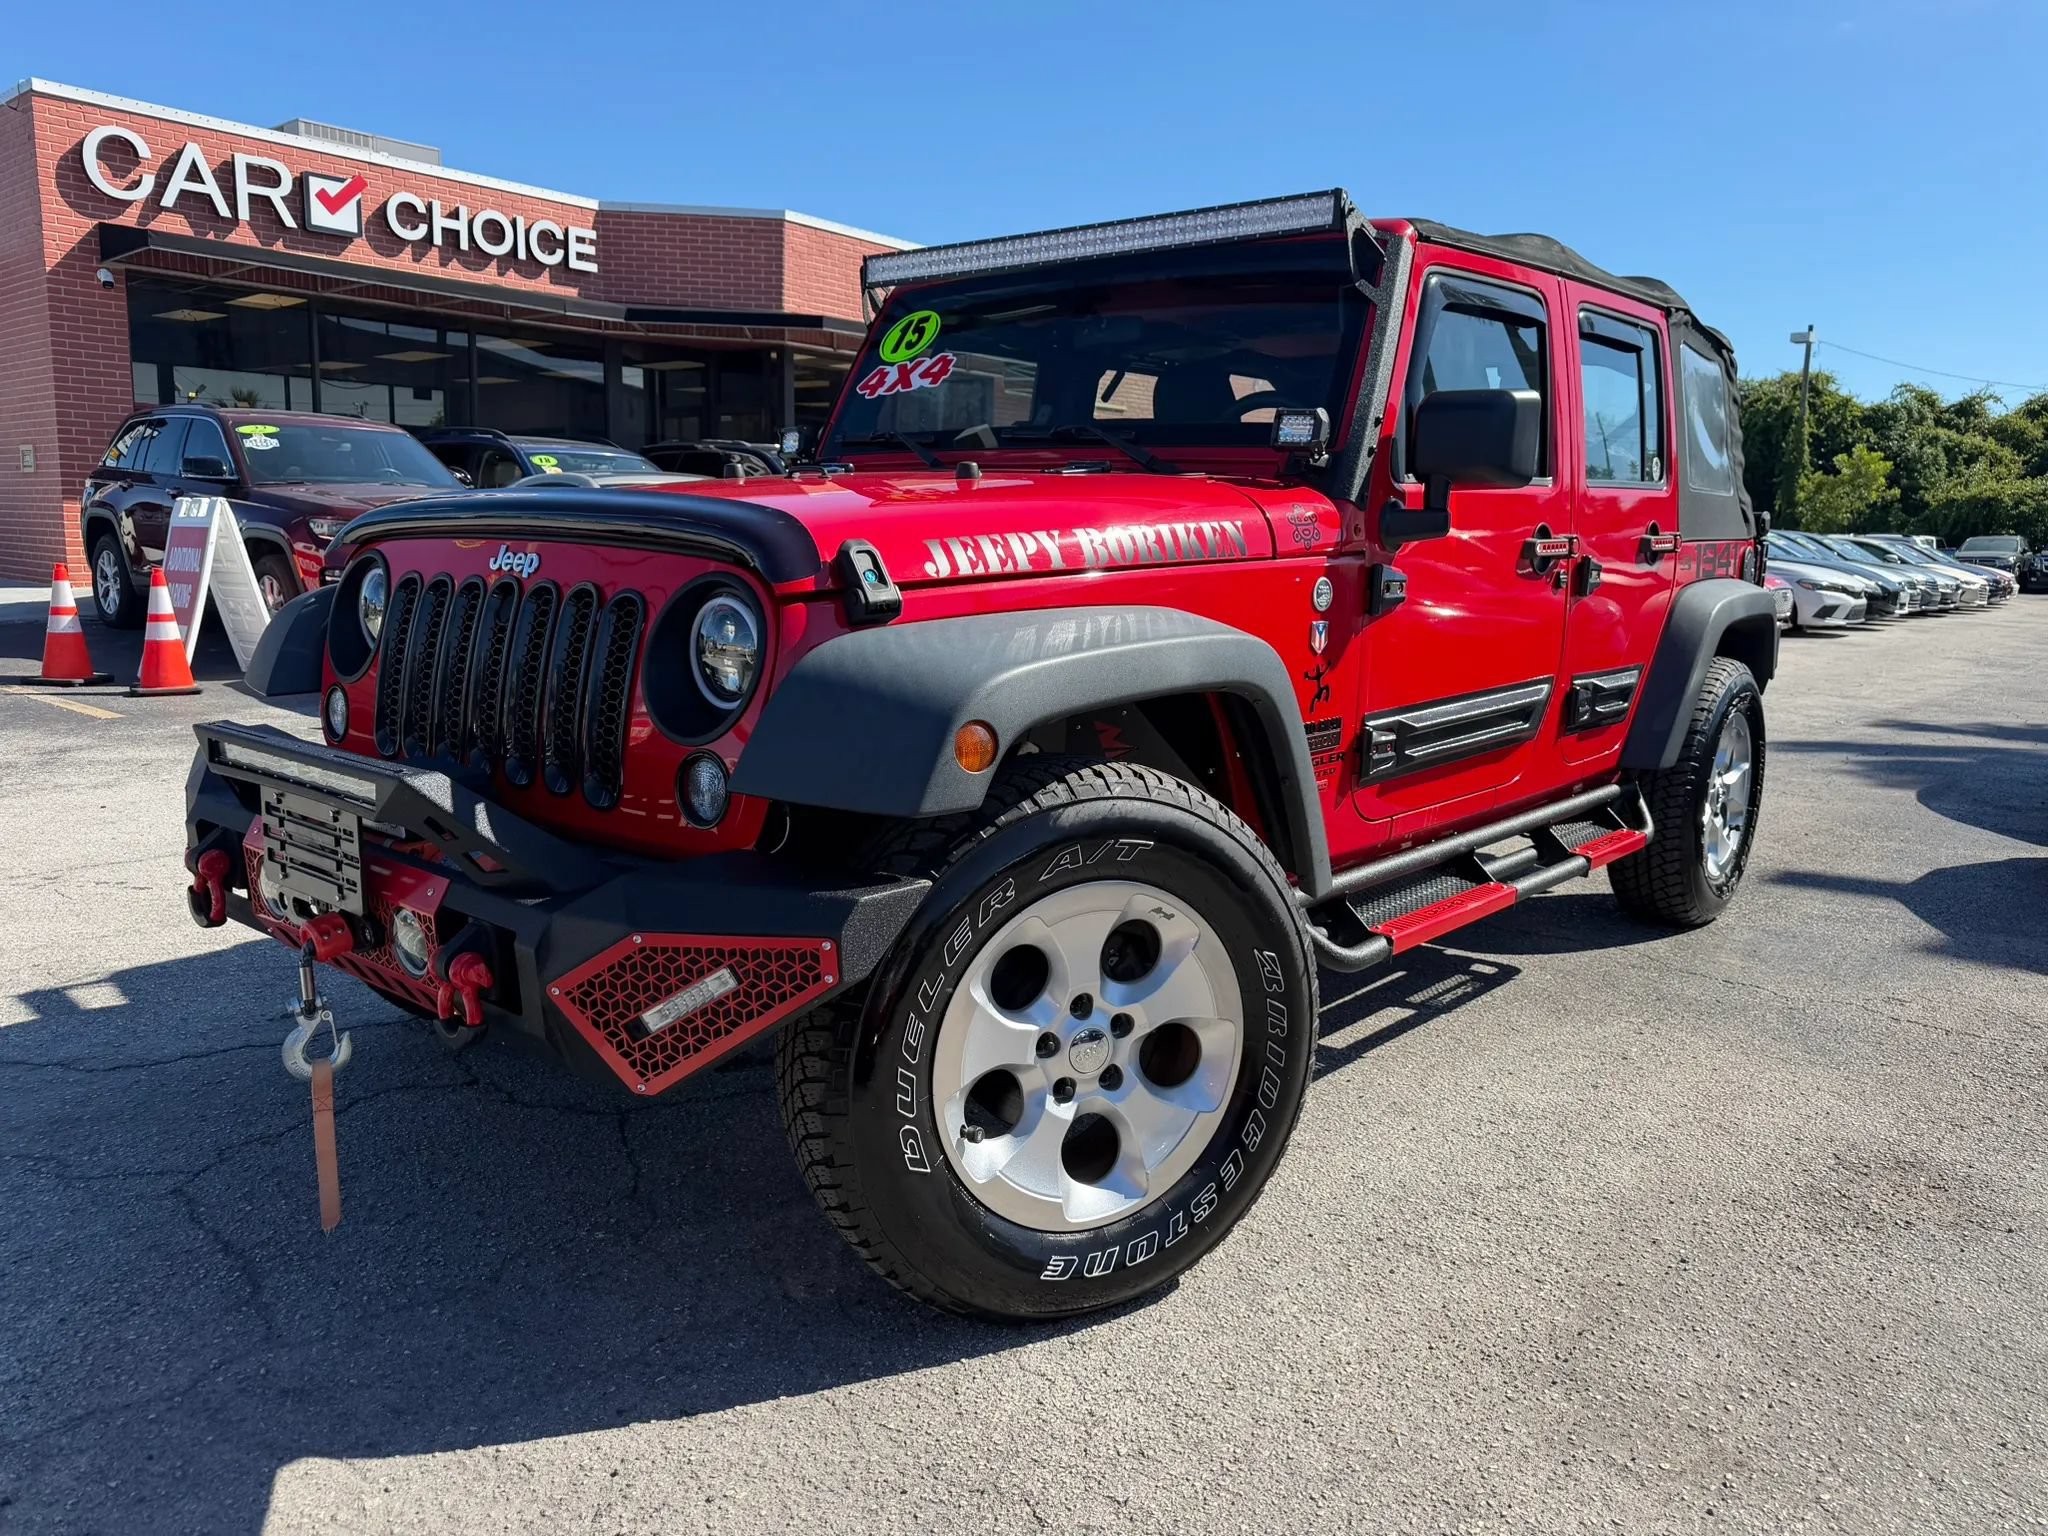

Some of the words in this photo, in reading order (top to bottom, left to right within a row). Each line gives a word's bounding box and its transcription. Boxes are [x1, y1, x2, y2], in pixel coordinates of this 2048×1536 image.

[82, 125, 298, 228] CAR
[386, 192, 598, 273] CHOICE
[890, 315, 932, 355] 15
[857, 353, 956, 398] 4X4
[489, 544, 540, 579] Jeep
[922, 529, 1066, 578] JEEPY
[1072, 520, 1248, 567] BORIKEN
[1696, 543, 1740, 579] 1941
[1312, 751, 1345, 767] GLER
[897, 878, 1016, 1174] DUELER
[1039, 838, 1155, 882] A/T
[1040, 948, 1288, 1281] BRIDGESTONE
